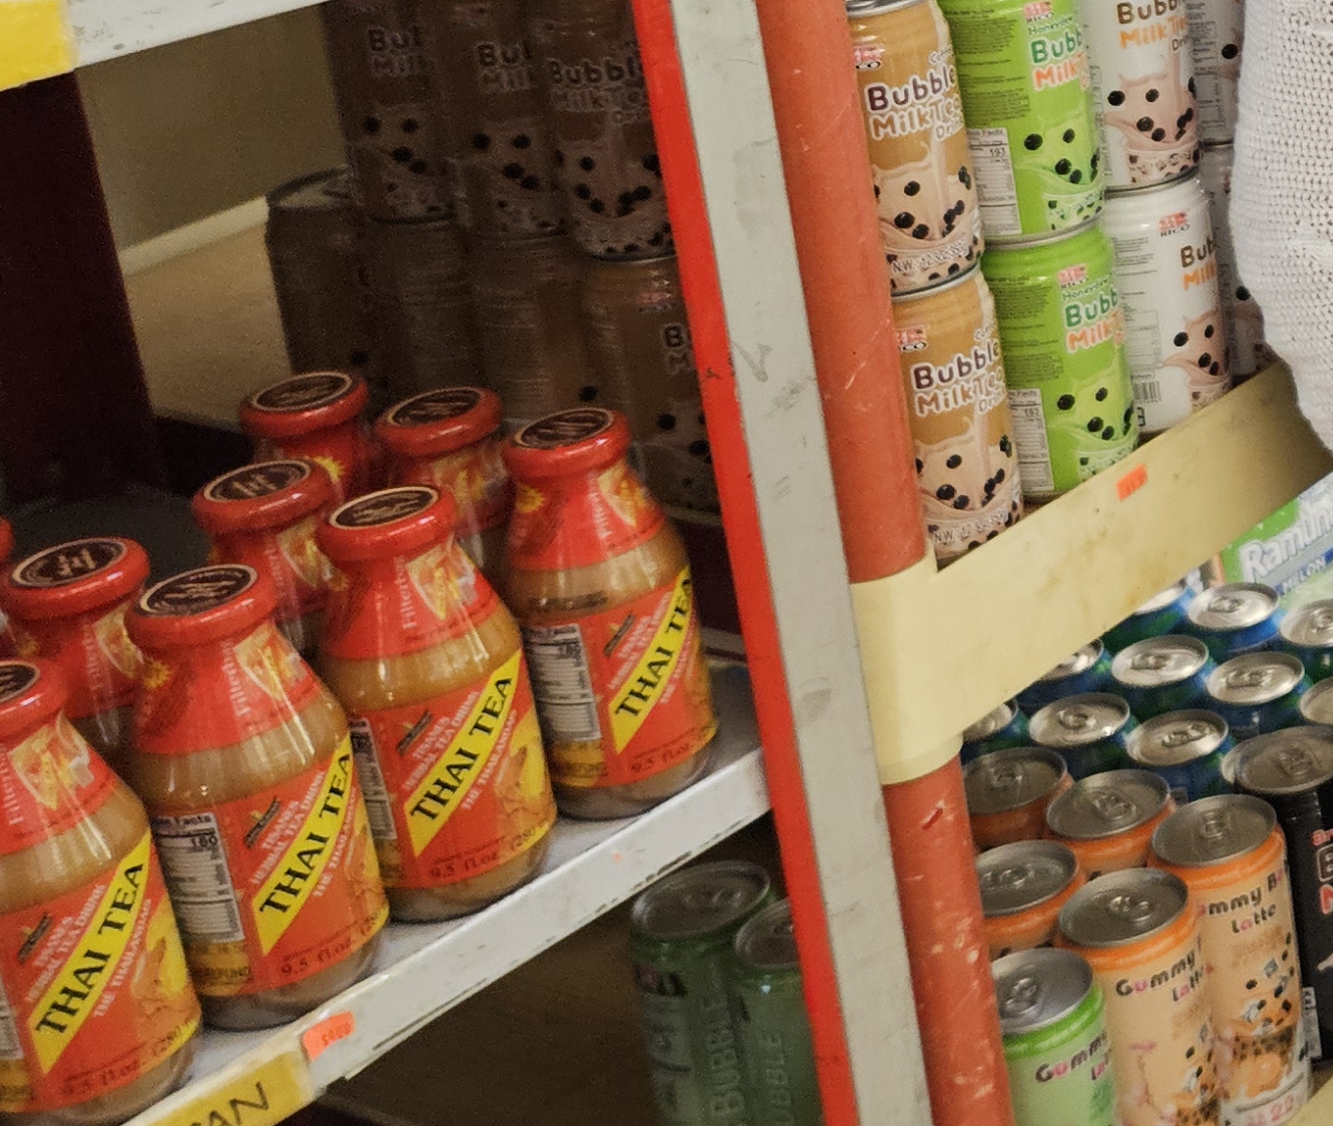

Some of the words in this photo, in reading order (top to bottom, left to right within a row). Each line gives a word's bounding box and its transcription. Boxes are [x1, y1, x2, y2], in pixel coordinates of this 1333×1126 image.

[1119, 22, 1167, 50] Milk
[550, 56, 643, 85] Bubbl
[867, 63, 957, 112] Bubble
[1033, 55, 1078, 90] Milk
[871, 105, 933, 139] Milk
[1067, 321, 1112, 352] Milk
[912, 339, 1000, 391] Bubble
[915, 380, 974, 416] Milk
[614, 646, 675, 719] THAI
[665, 577, 692, 634] TEA
[409, 747, 479, 823] THAI
[468, 676, 512, 742] TEA
[258, 831, 331, 915] THAI
[317, 751, 352, 820] TEA
[35, 947, 113, 1035] THAI
[97, 862, 146, 940] TEA
